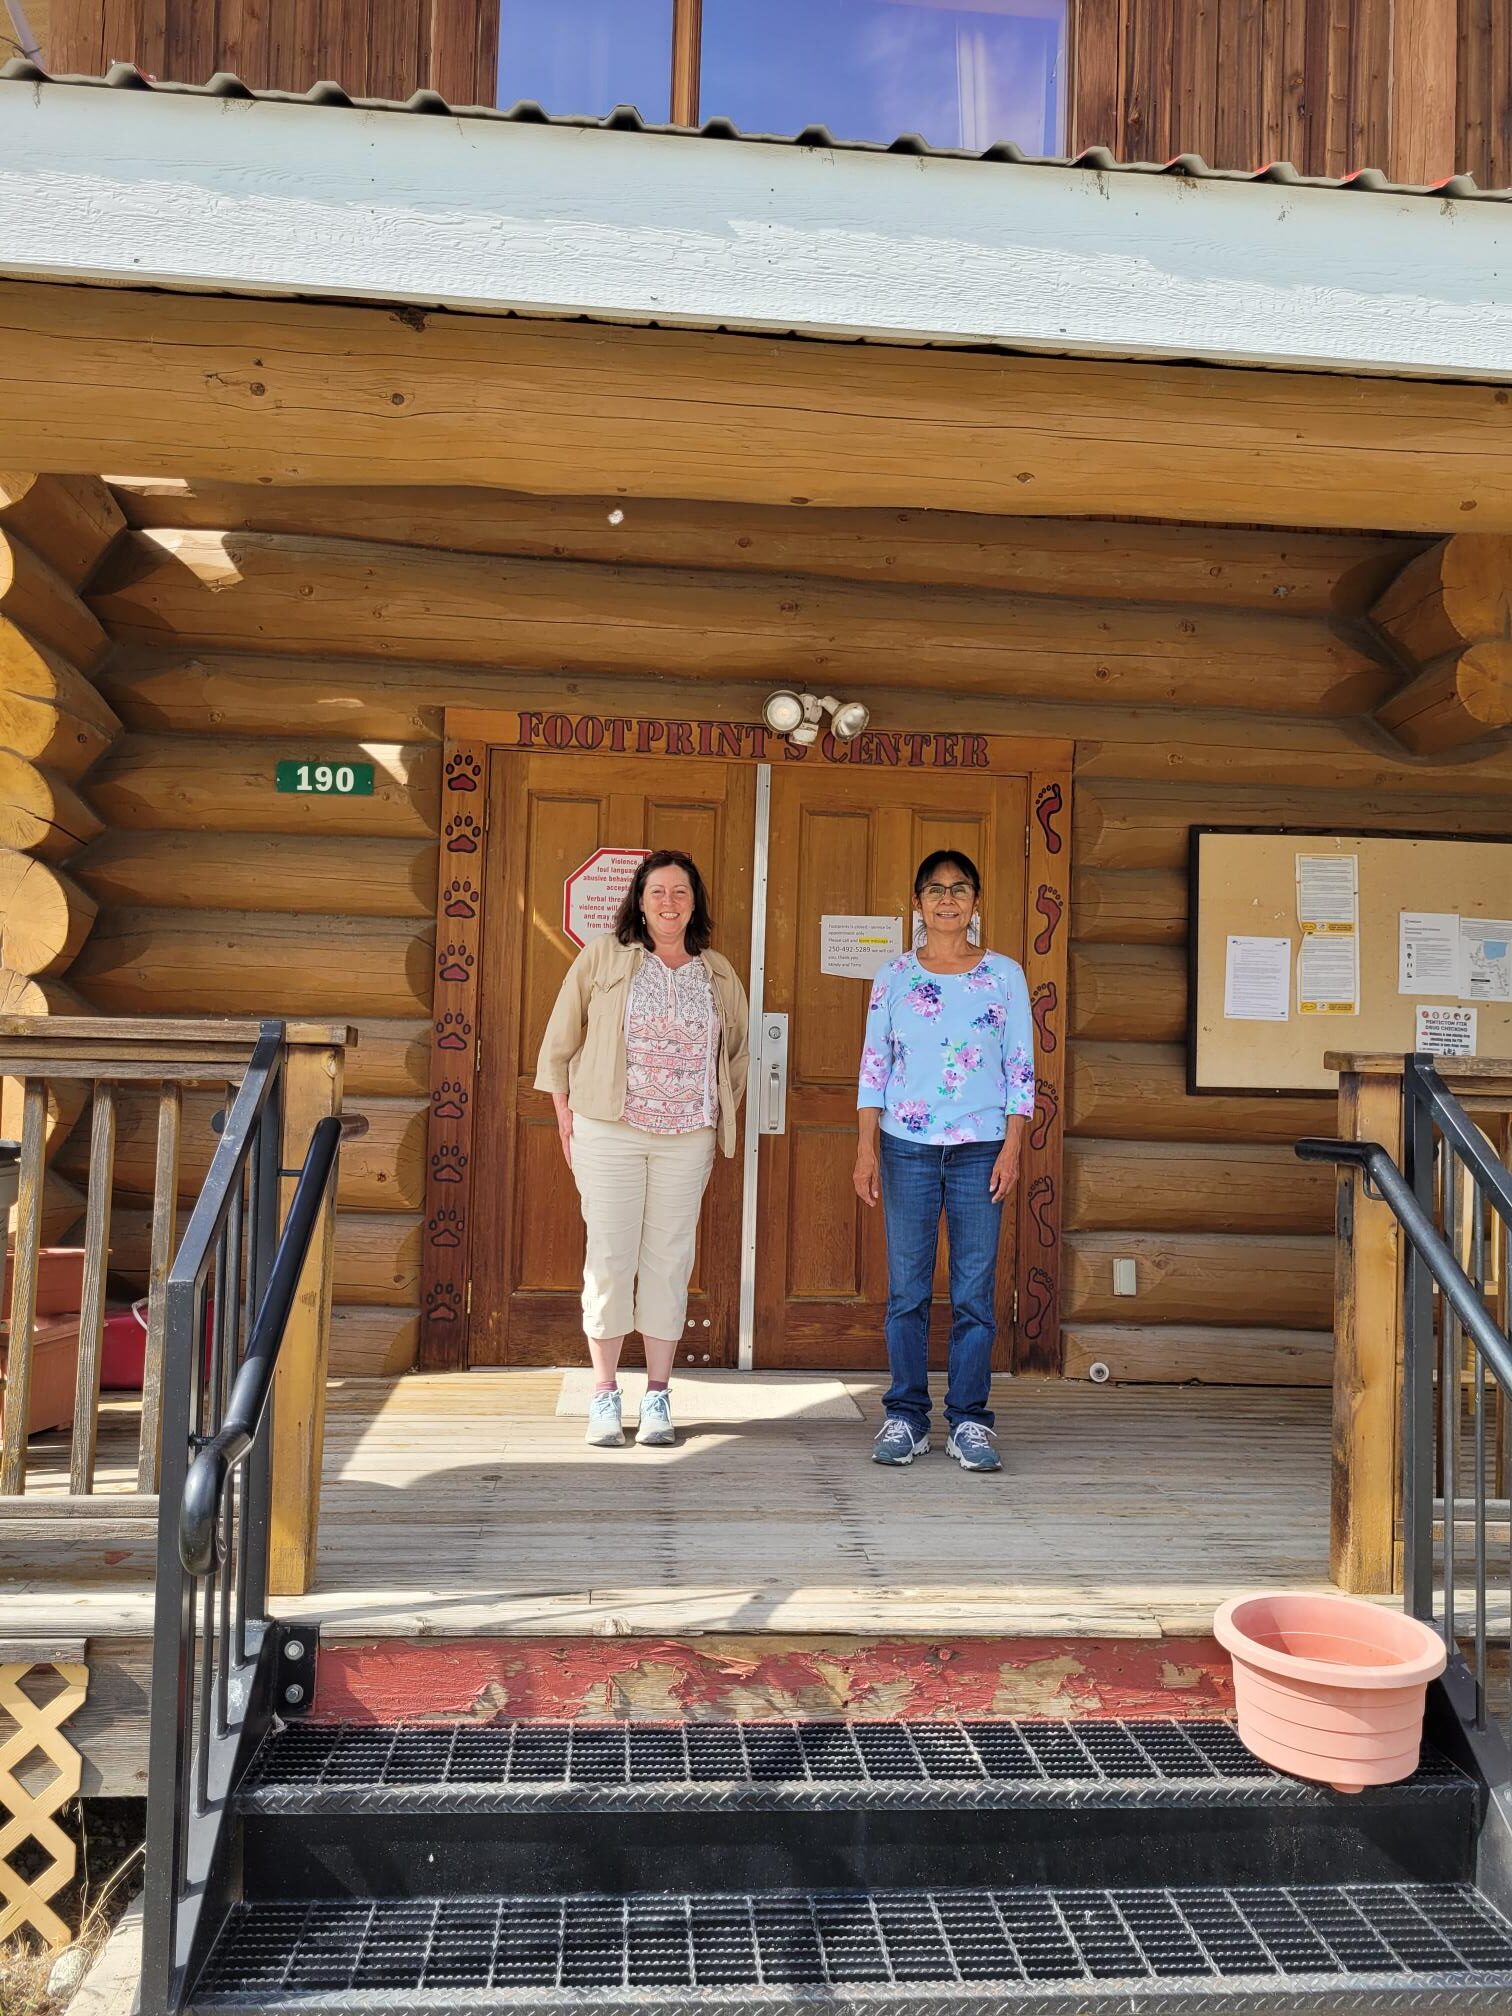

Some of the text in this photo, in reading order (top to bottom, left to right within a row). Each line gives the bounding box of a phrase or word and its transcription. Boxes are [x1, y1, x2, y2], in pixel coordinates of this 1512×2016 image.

[821, 730, 990, 768] CENTER
[296, 765, 355, 792] 190
[611, 858, 640, 866] Violence,
[587, 921, 602, 929] from
